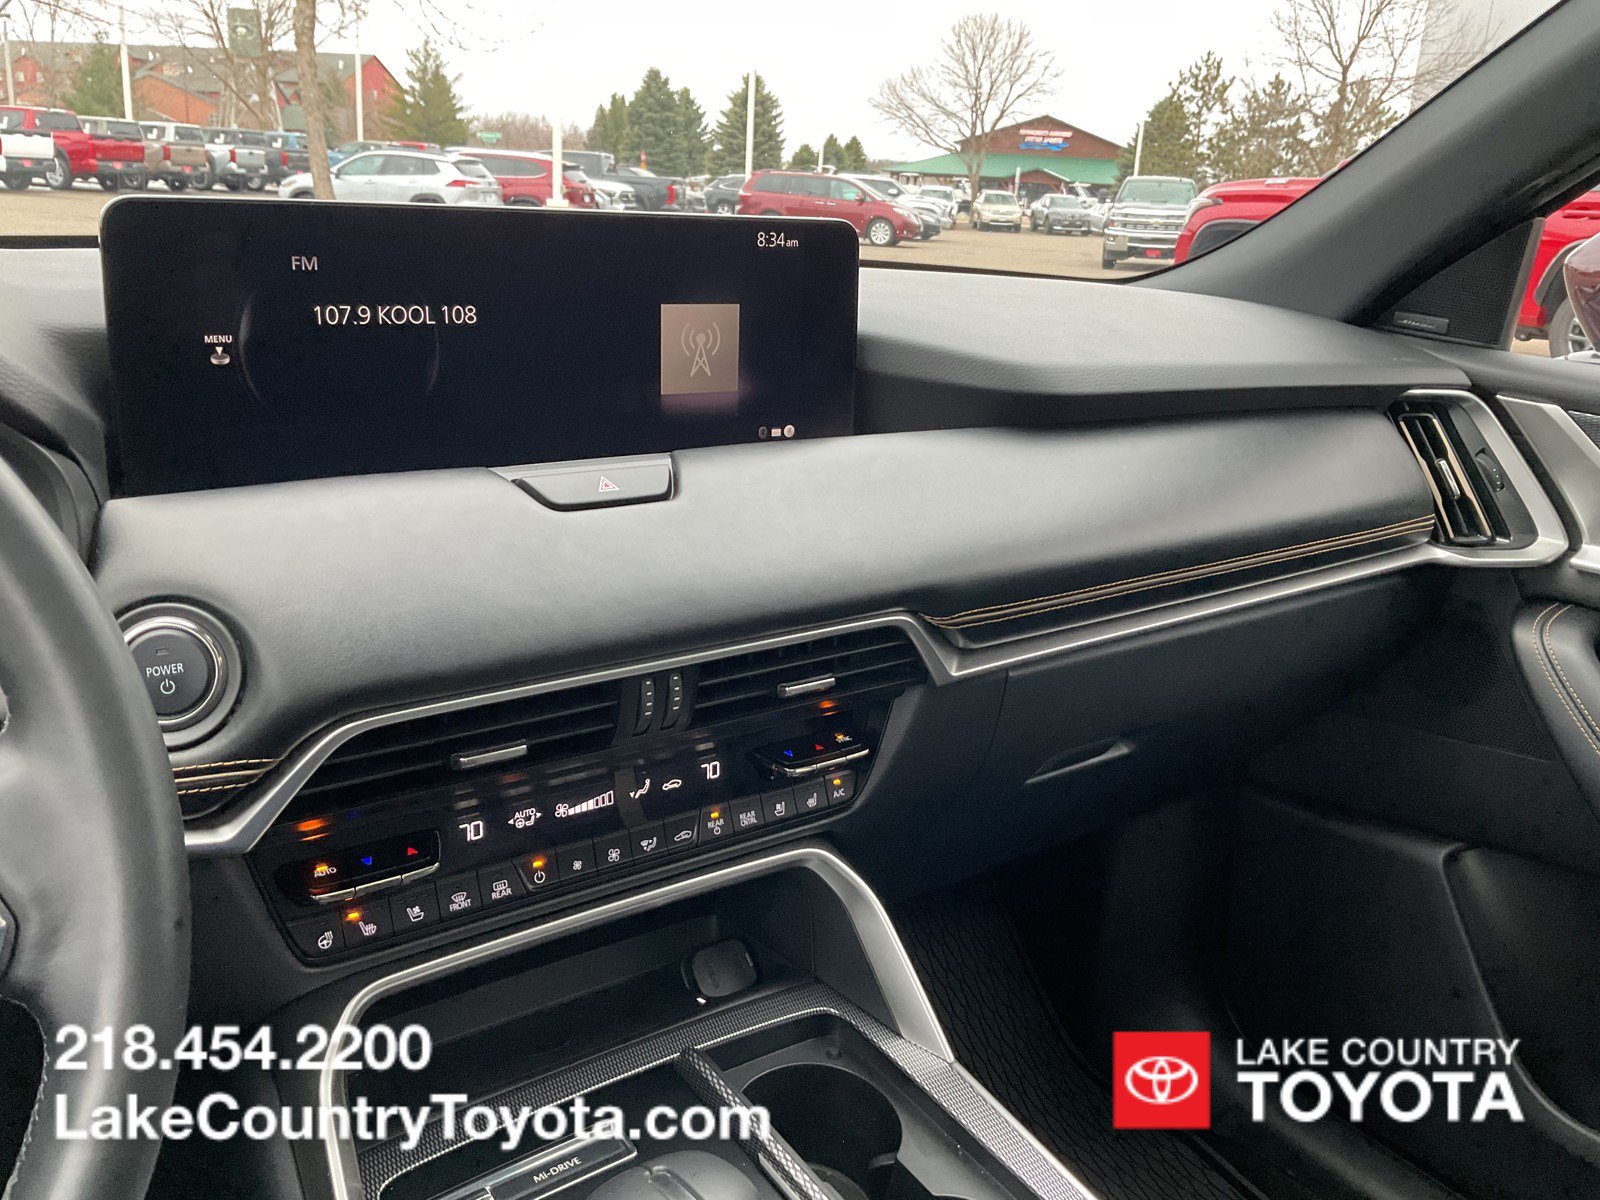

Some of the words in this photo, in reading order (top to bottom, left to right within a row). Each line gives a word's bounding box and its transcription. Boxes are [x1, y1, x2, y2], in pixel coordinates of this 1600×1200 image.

[757, 231, 799, 247] 8:34am
[290, 255, 319, 271] FM
[313, 305, 371, 325] 107.9
[377, 305, 437, 325] KOOL
[440, 305, 477, 324] 108
[204, 334, 233, 344] MENU
[145, 662, 185, 678] POWER
[700, 760, 721, 780] 70
[832, 788, 846, 799] A/C
[514, 808, 537, 820] AUTO
[739, 810, 756, 820] REAR
[458, 820, 484, 842] 70
[707, 818, 725, 829] REAR
[491, 887, 512, 900] REAR
[449, 898, 472, 912] FRONT
[533, 1156, 582, 1184] Mi-DRIVE
